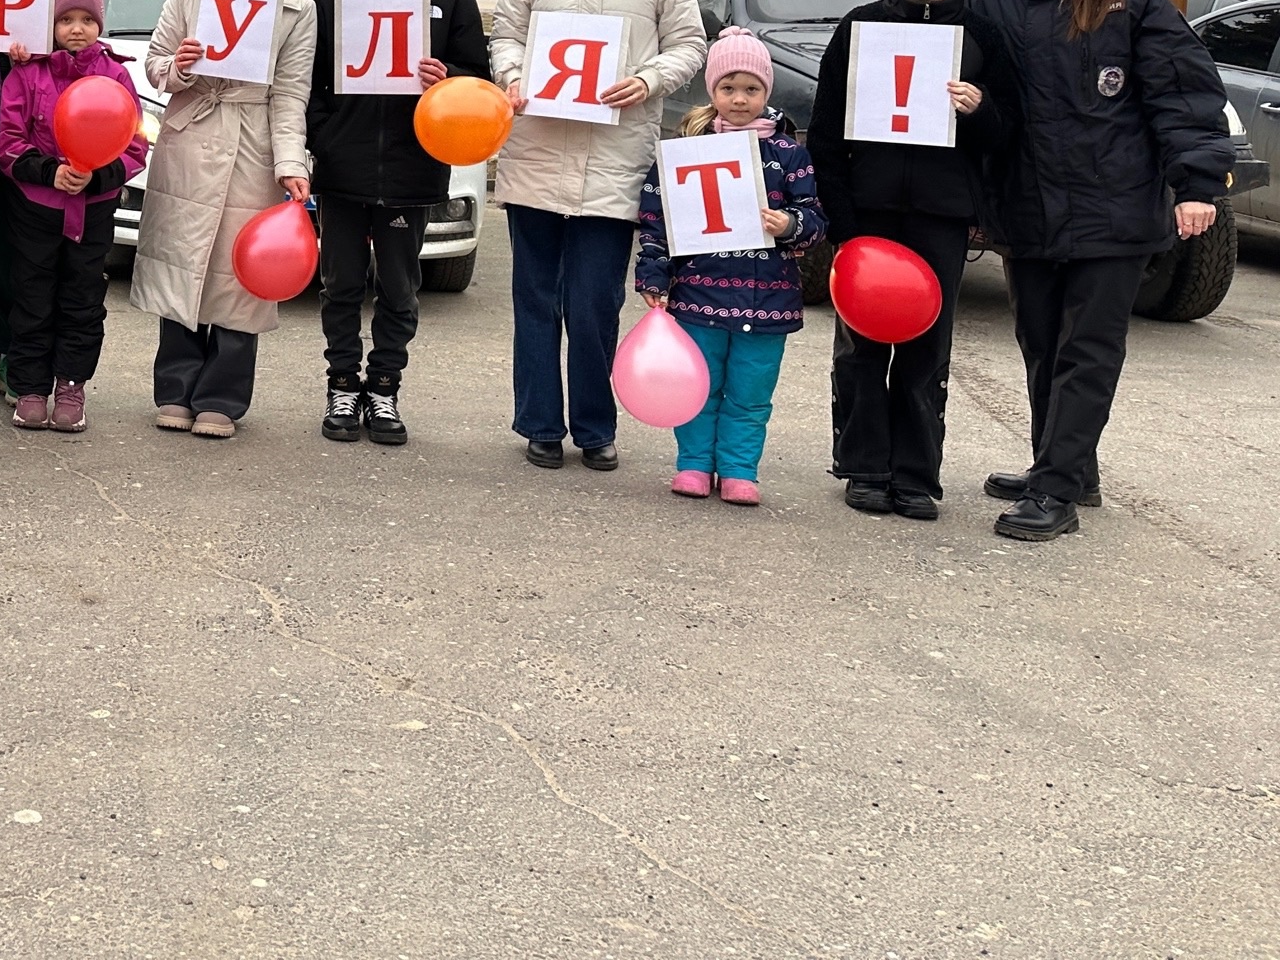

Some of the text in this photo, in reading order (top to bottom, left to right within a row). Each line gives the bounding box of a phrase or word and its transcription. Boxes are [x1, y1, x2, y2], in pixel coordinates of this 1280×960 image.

[346, 11, 414, 78] Л
[535, 39, 609, 105] Я
[891, 55, 916, 133] !
[676, 160, 741, 234] Т
